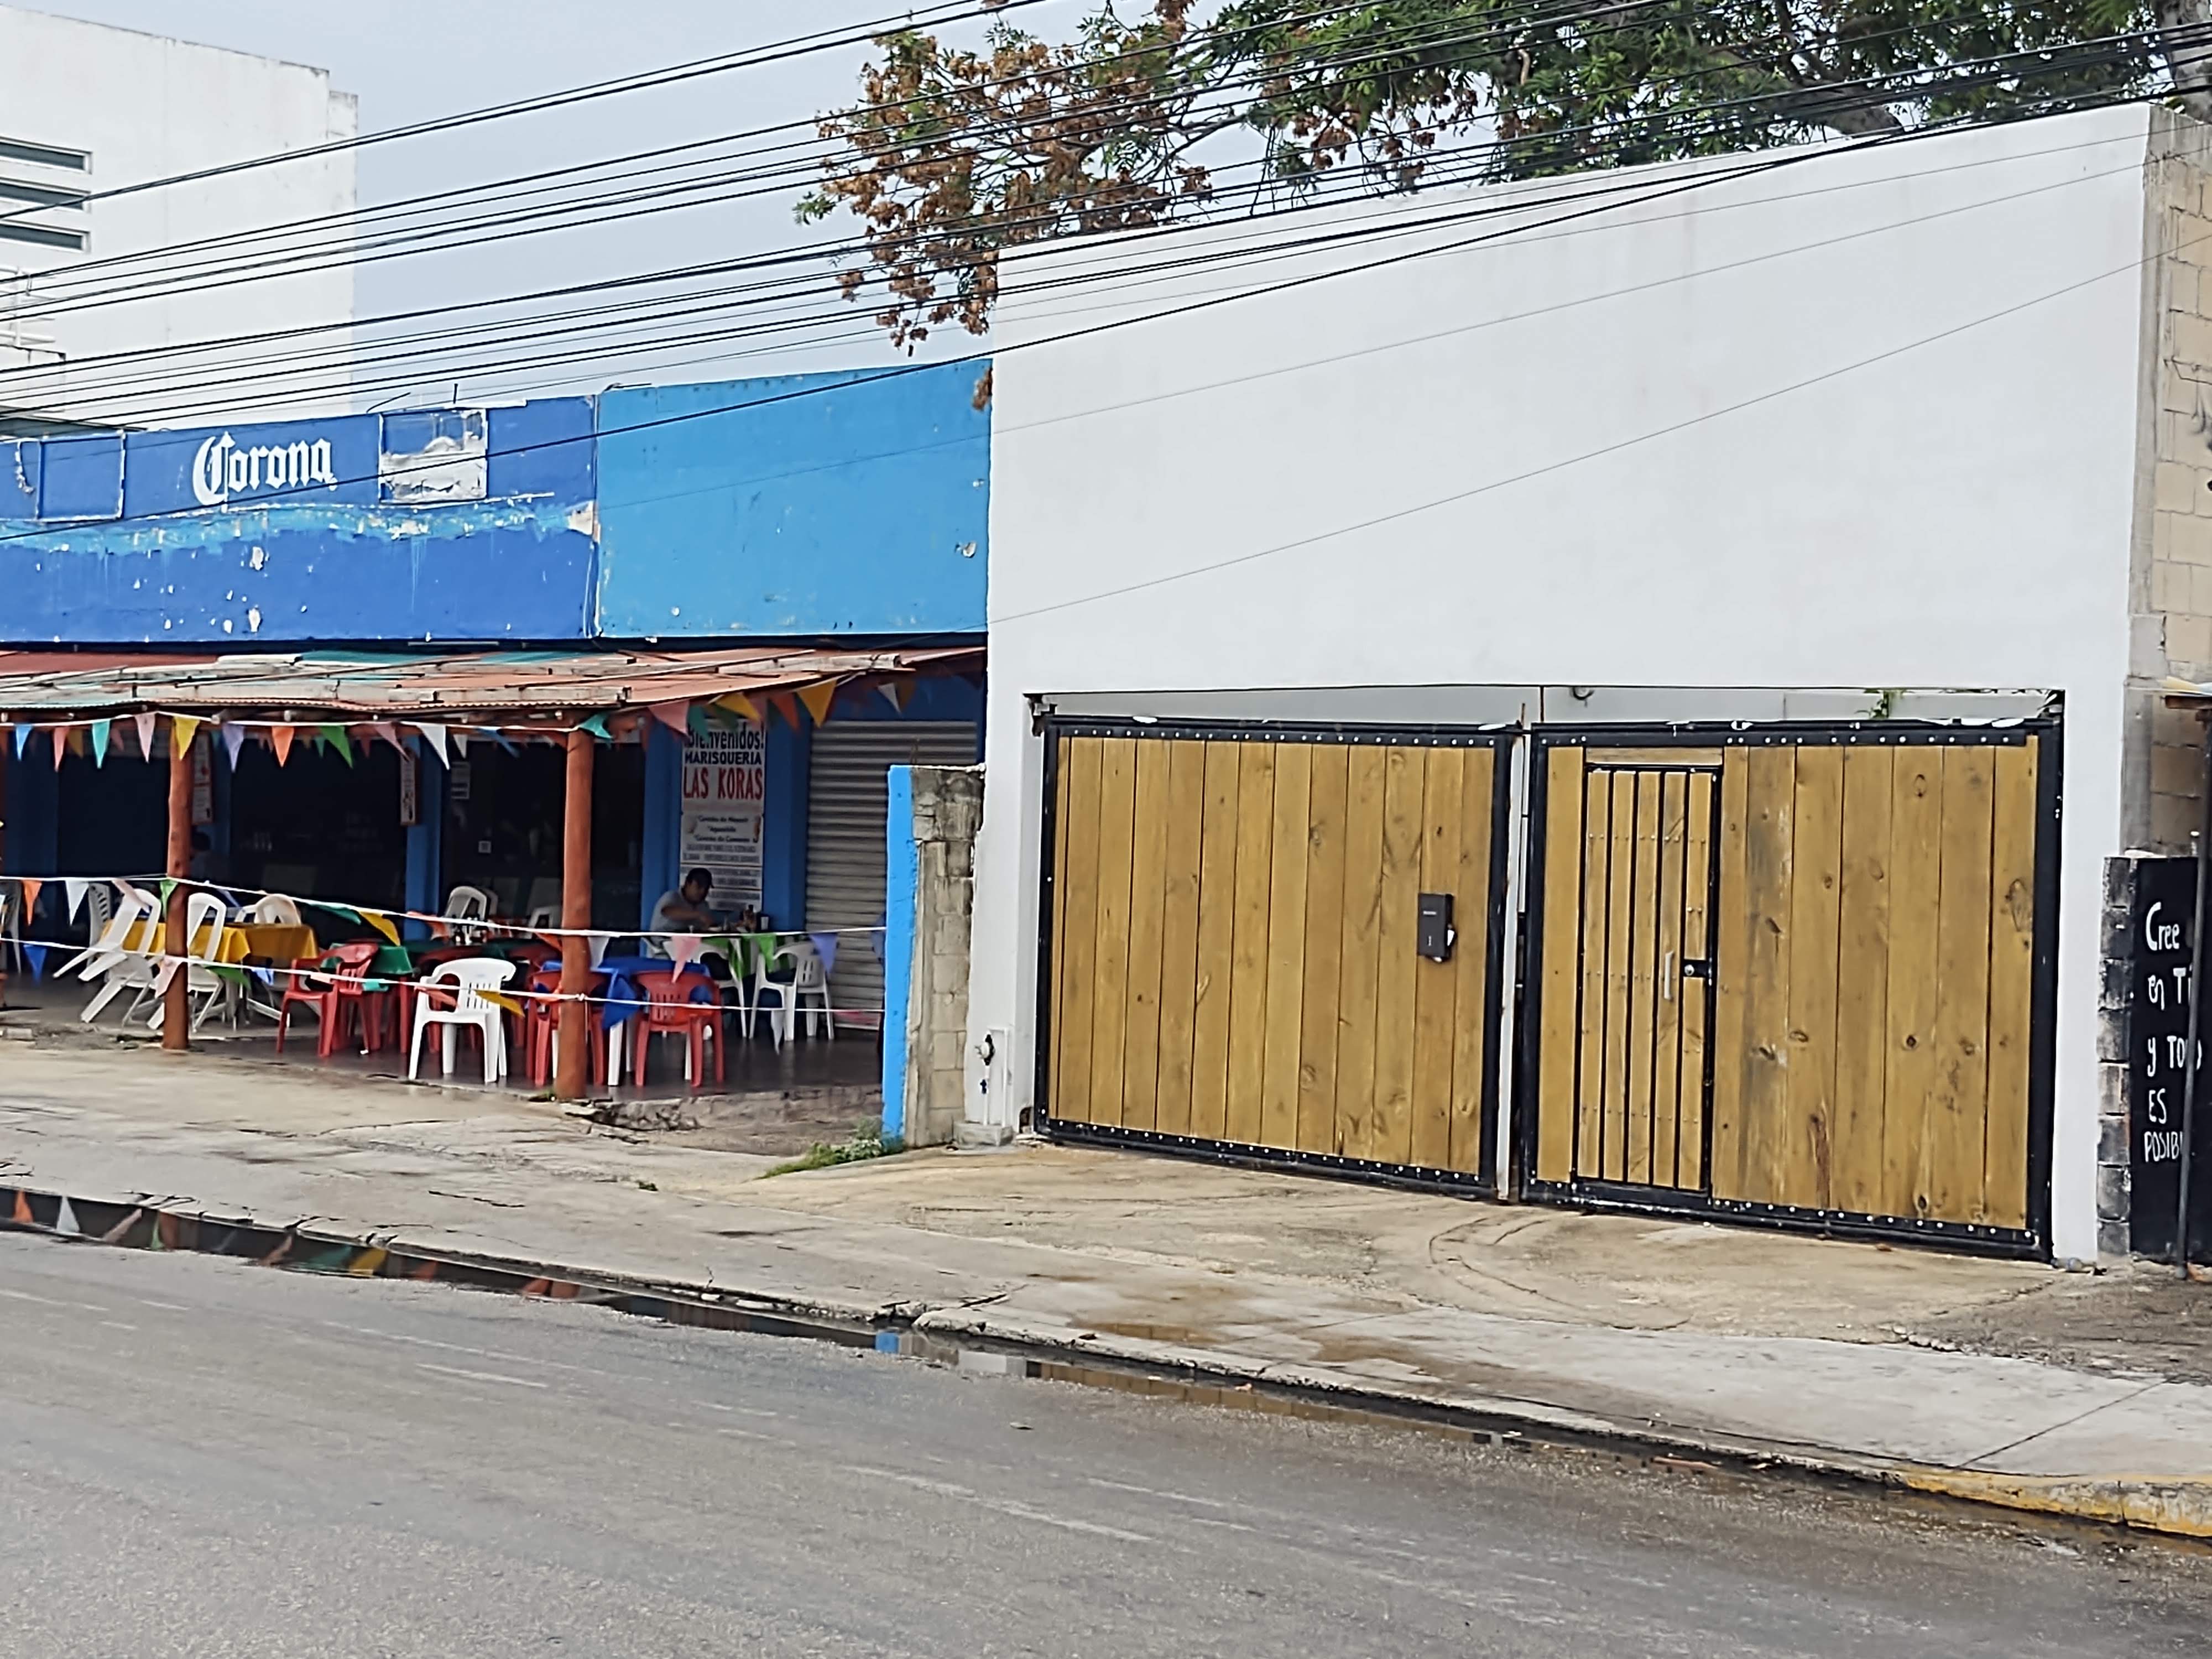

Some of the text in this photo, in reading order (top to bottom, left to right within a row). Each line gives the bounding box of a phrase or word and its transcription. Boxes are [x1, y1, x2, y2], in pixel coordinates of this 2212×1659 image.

[192, 431, 338, 513] Corona
[685, 751, 761, 765] MARISQUERIA
[684, 766, 763, 800] LAS KORAS
[2146, 901, 2179, 951] Cree
[2148, 975, 2164, 1010] en
[2167, 1036, 2203, 1070] TO
[2149, 1088, 2167, 1124] ES
[2144, 1131, 2184, 1162] POSIB
